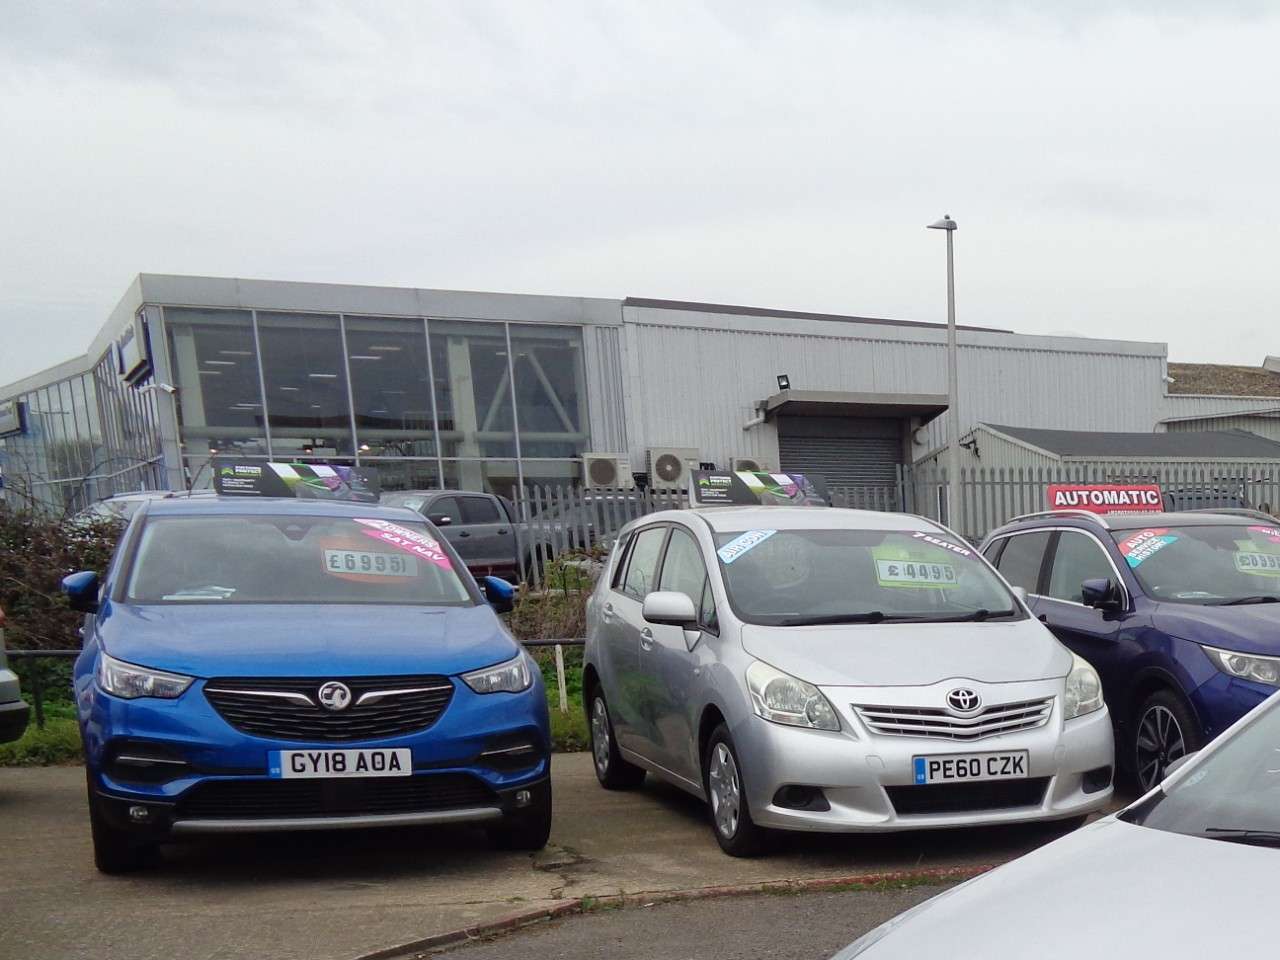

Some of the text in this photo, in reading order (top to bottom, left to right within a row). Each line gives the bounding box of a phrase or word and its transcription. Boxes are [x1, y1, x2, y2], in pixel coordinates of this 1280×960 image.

[1055, 490, 1158, 505] AUTOMATIC
[381, 532, 446, 560] SAT NAV
[923, 536, 971, 556] SEATER
[1126, 531, 1155, 549] AUTO
[291, 752, 347, 772] GY18
[929, 756, 1024, 779] PE60 CZK
